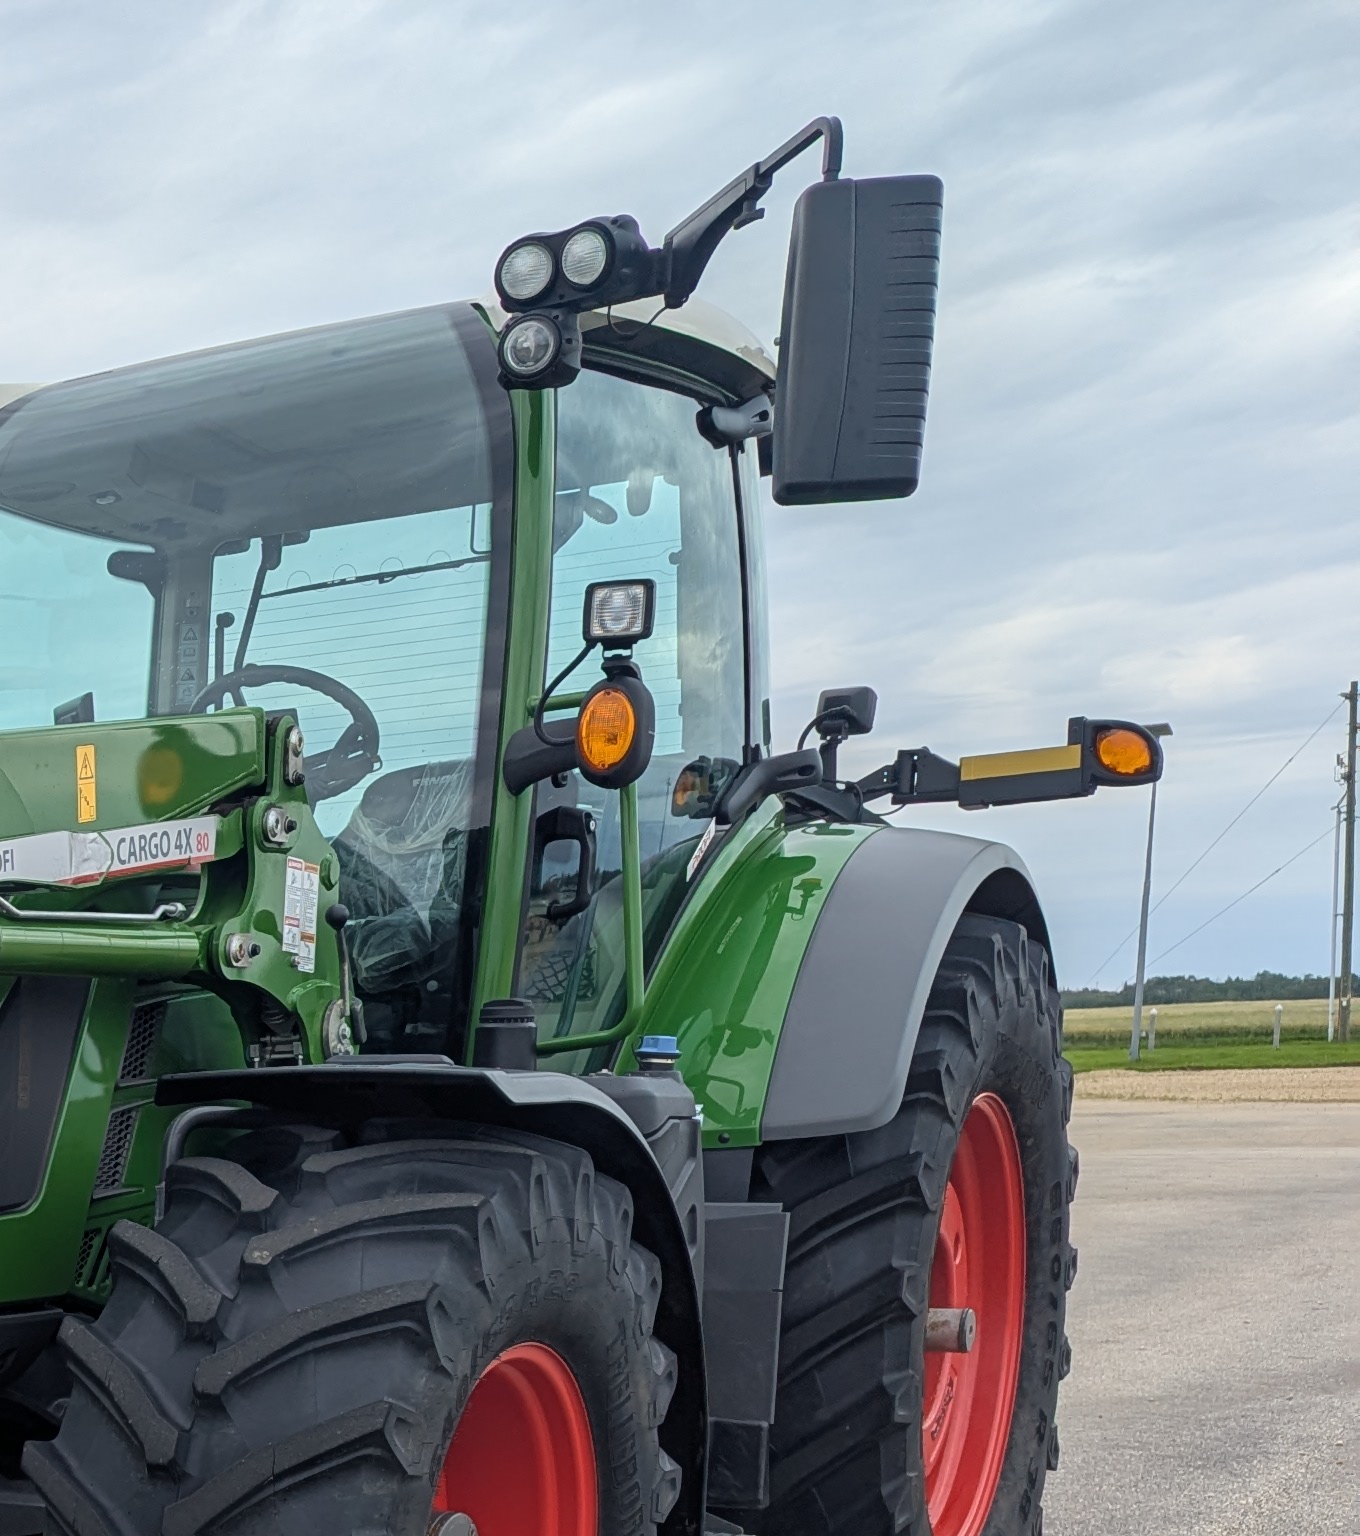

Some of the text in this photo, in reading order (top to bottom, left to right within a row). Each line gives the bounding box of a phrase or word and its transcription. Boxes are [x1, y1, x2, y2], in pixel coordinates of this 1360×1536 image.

[117, 828, 209, 865] CARGO 4X 80
